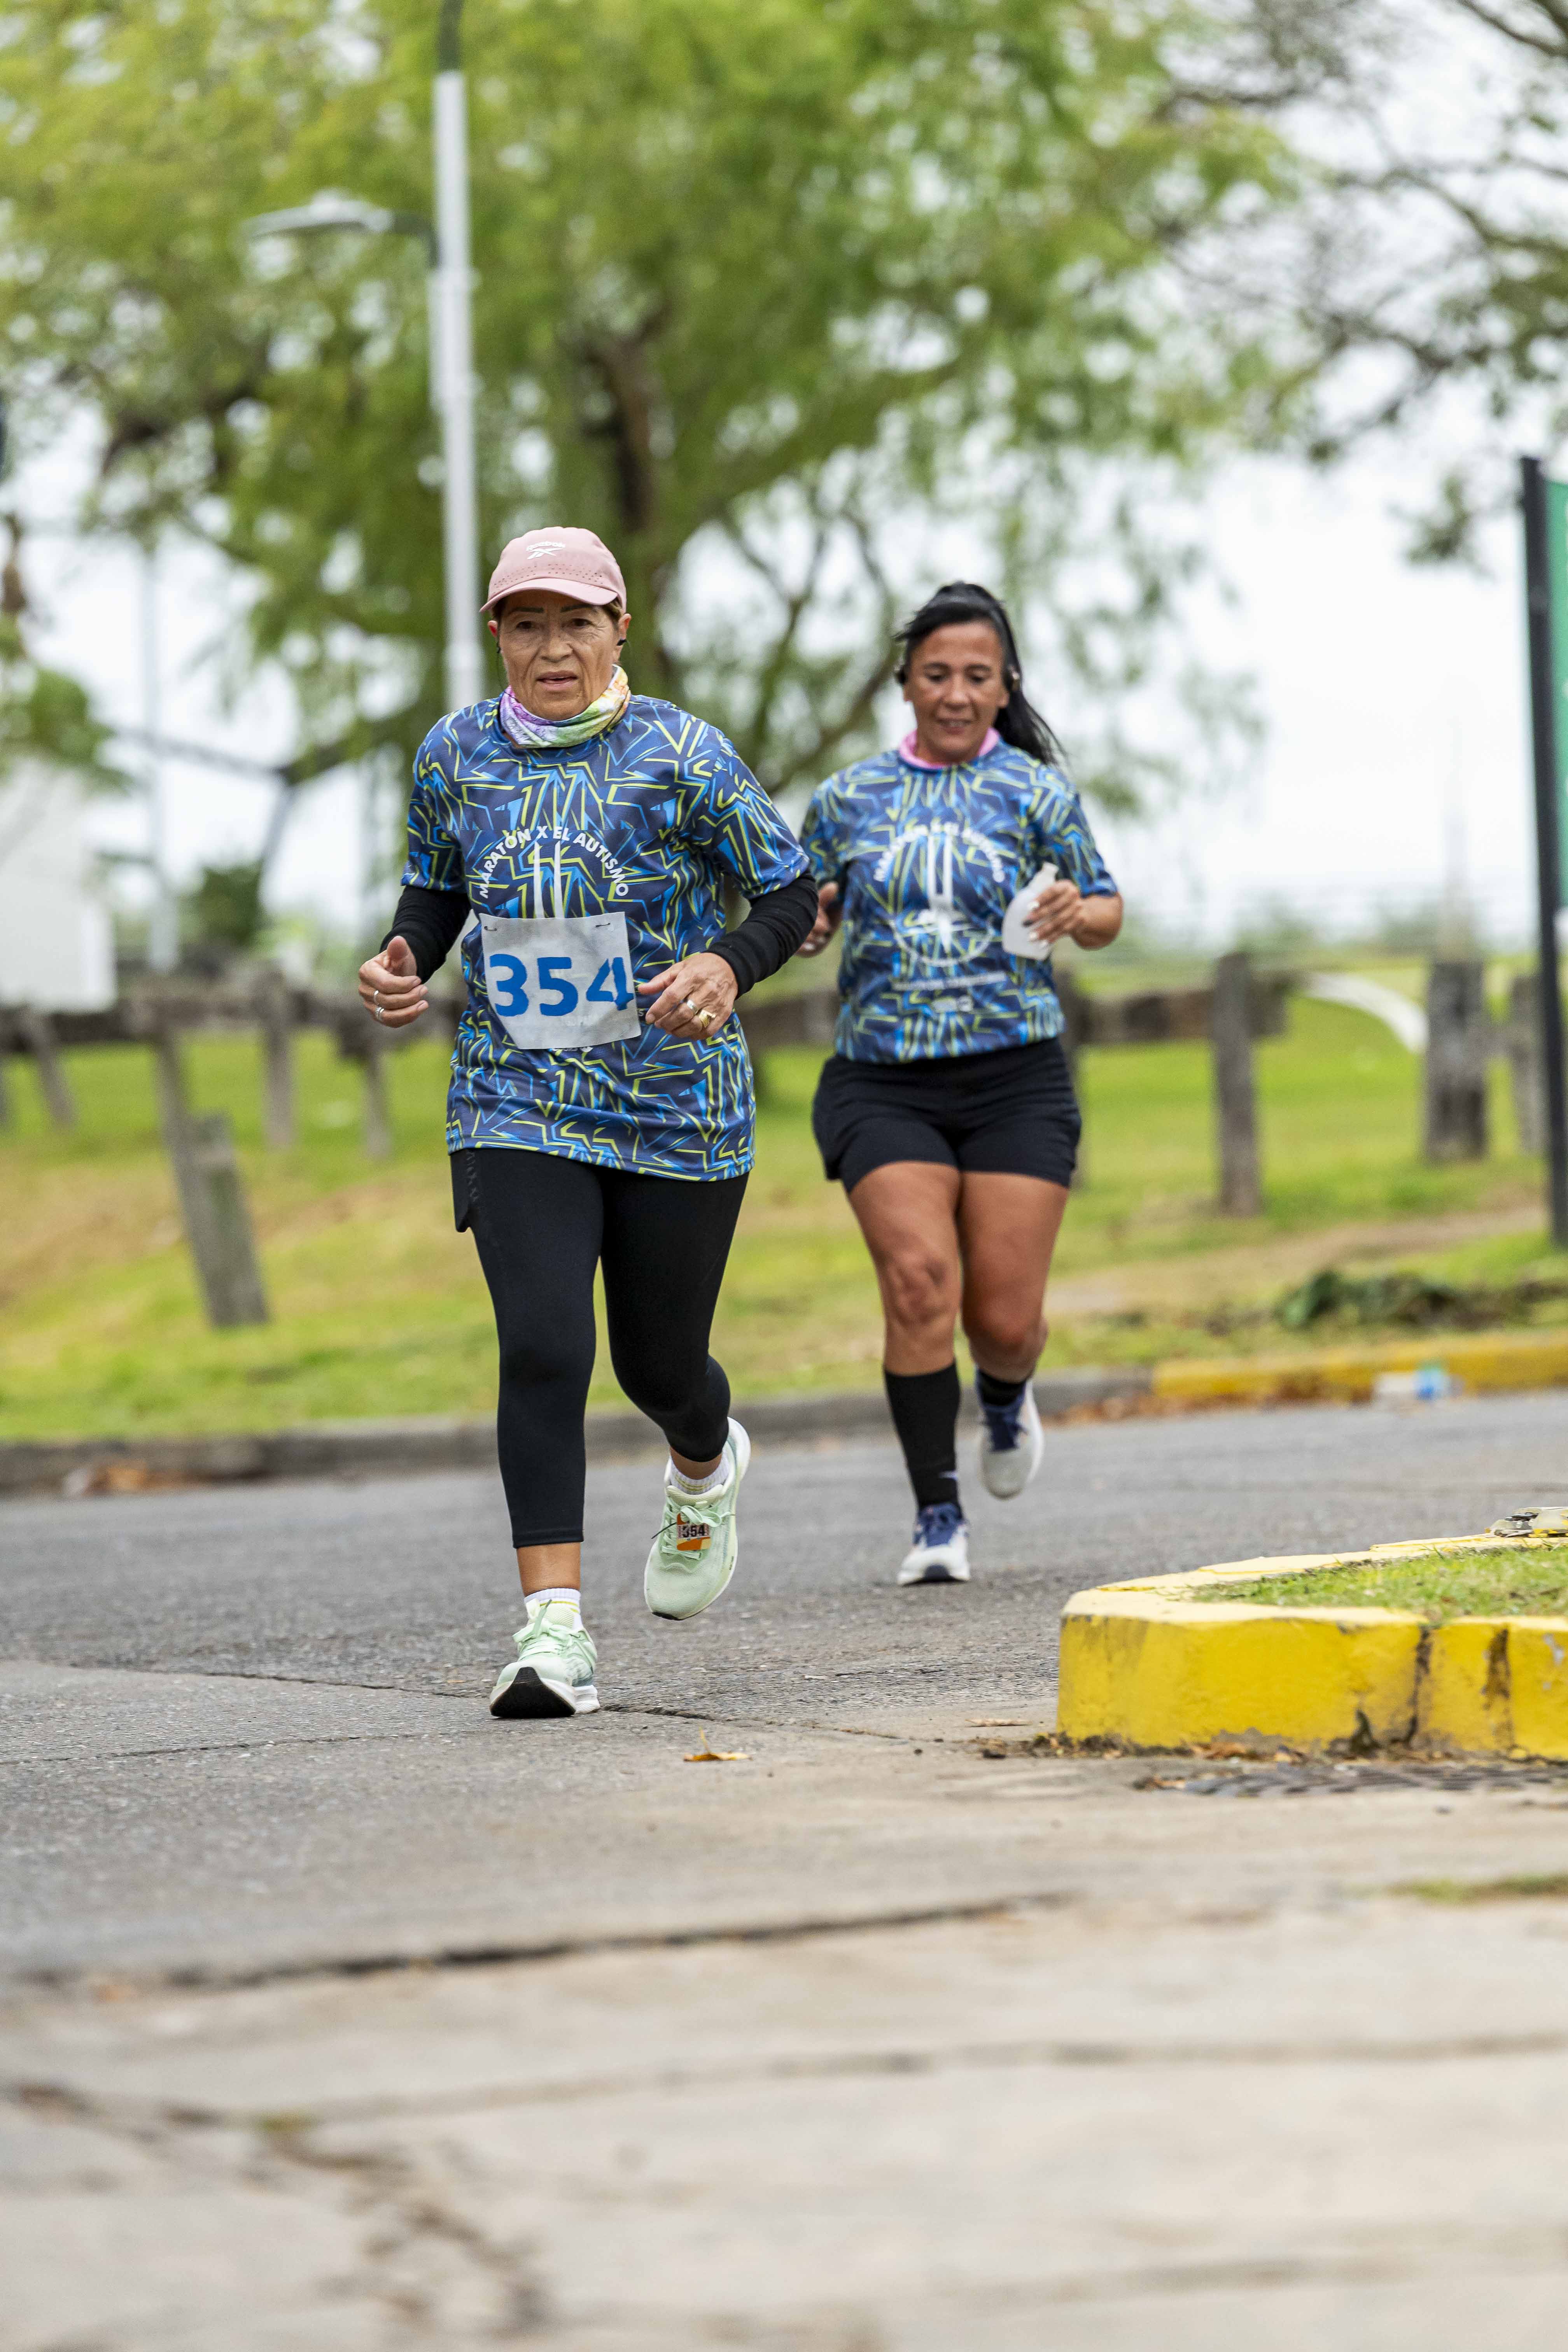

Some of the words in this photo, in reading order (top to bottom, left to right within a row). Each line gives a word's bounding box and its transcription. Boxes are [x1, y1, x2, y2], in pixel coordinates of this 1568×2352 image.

[536, 826, 548, 839] X
[553, 826, 570, 841] EL
[572, 833, 629, 896] AUTISMO
[489, 954, 634, 1017] 354
[682, 1524, 705, 1538] 354
